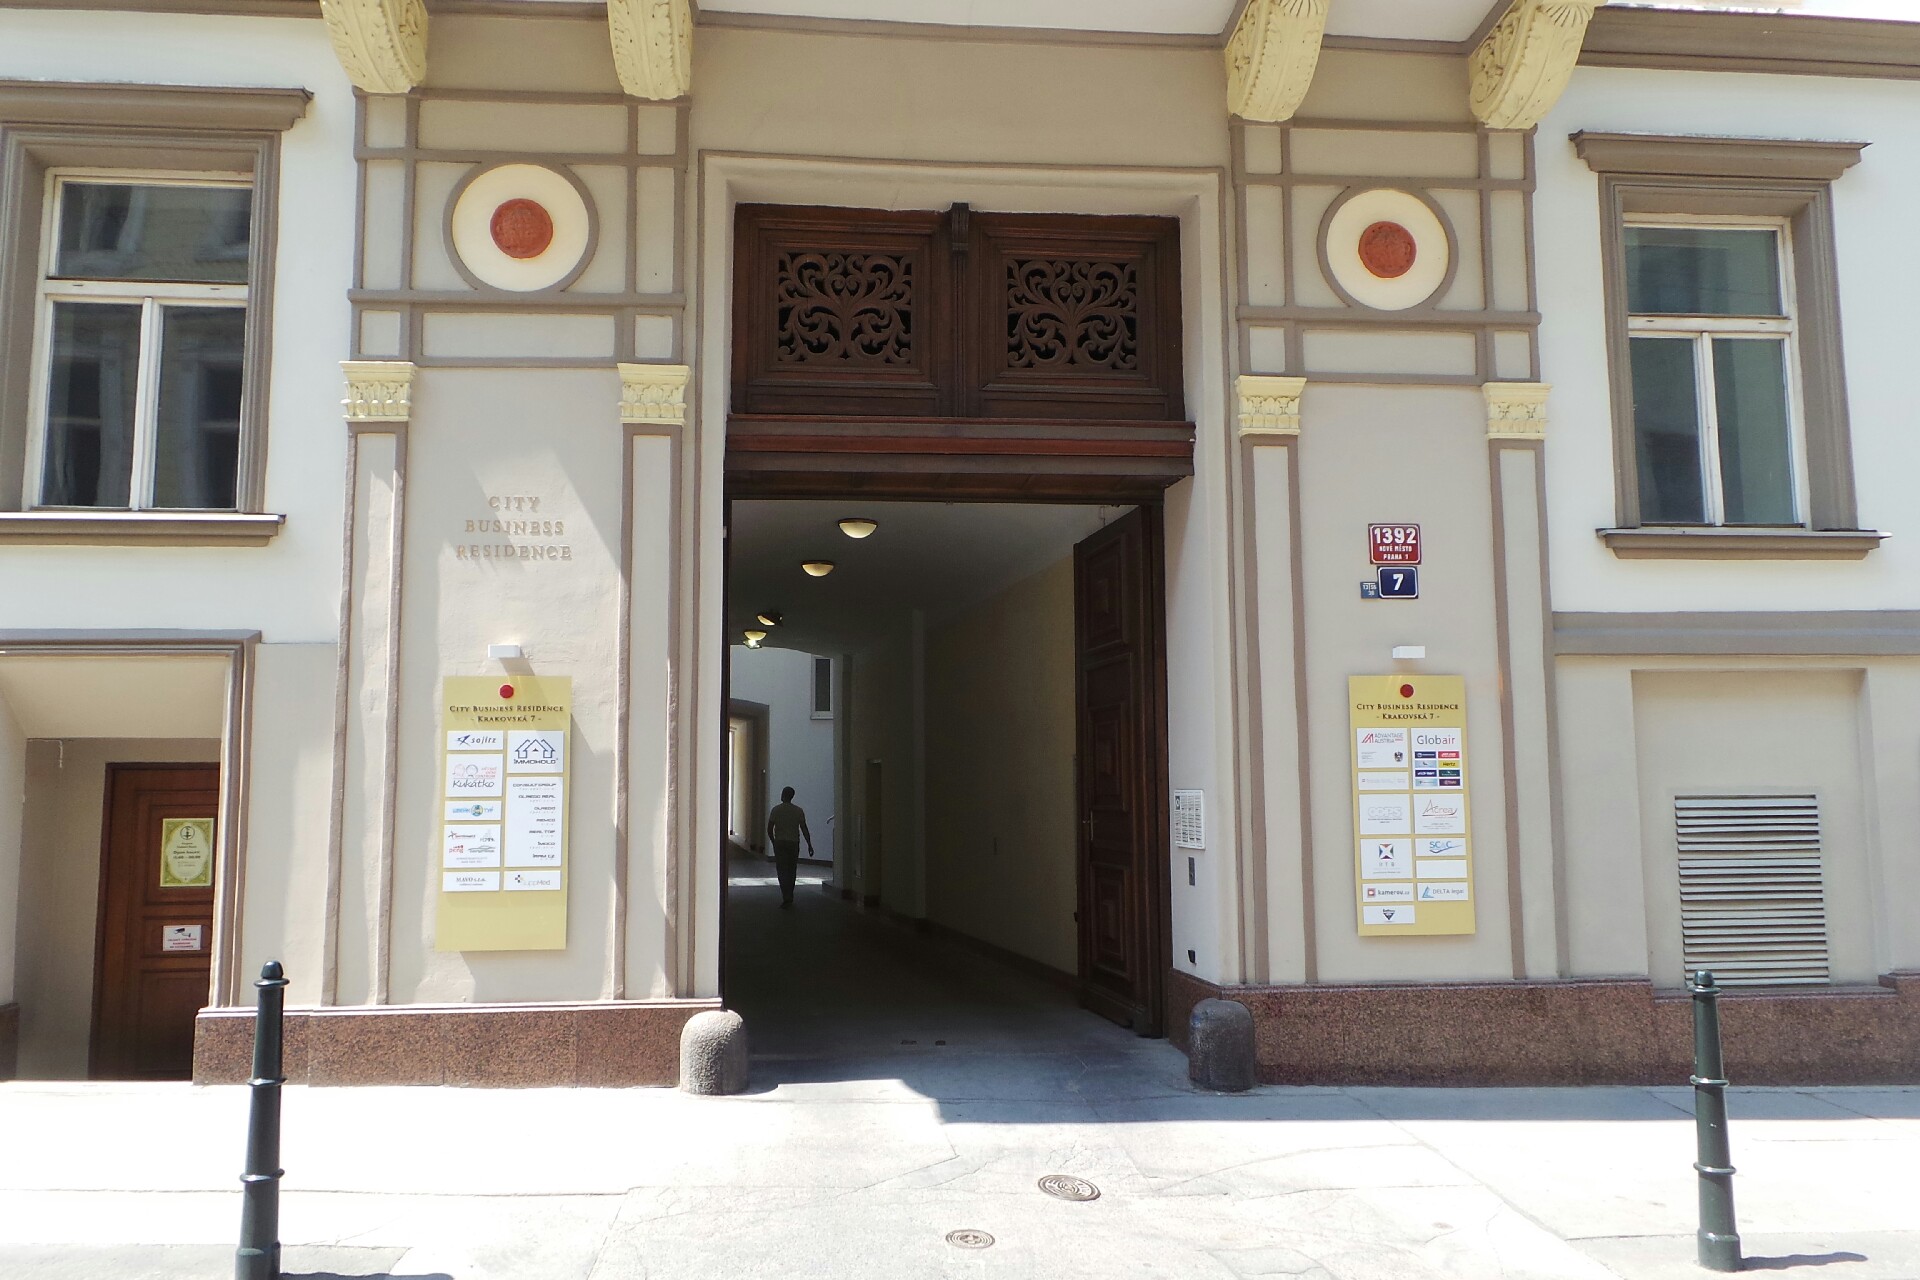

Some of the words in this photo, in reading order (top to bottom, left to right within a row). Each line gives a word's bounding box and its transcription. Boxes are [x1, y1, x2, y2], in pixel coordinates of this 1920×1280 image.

[488, 495, 540, 512] CITY
[464, 519, 565, 536] BUSINESS
[1374, 527, 1417, 544] 1392
[456, 544, 573, 561] RESIDENCE
[1379, 544, 1393, 552] NOVÉ
[1394, 544, 1412, 552] MĚSTO
[1392, 573, 1404, 591] 7
[477, 715, 528, 723] KRAKOVSKÁ
[1382, 712, 1428, 720] KRAKOVSKÁ
[1416, 734, 1456, 745] Globair
